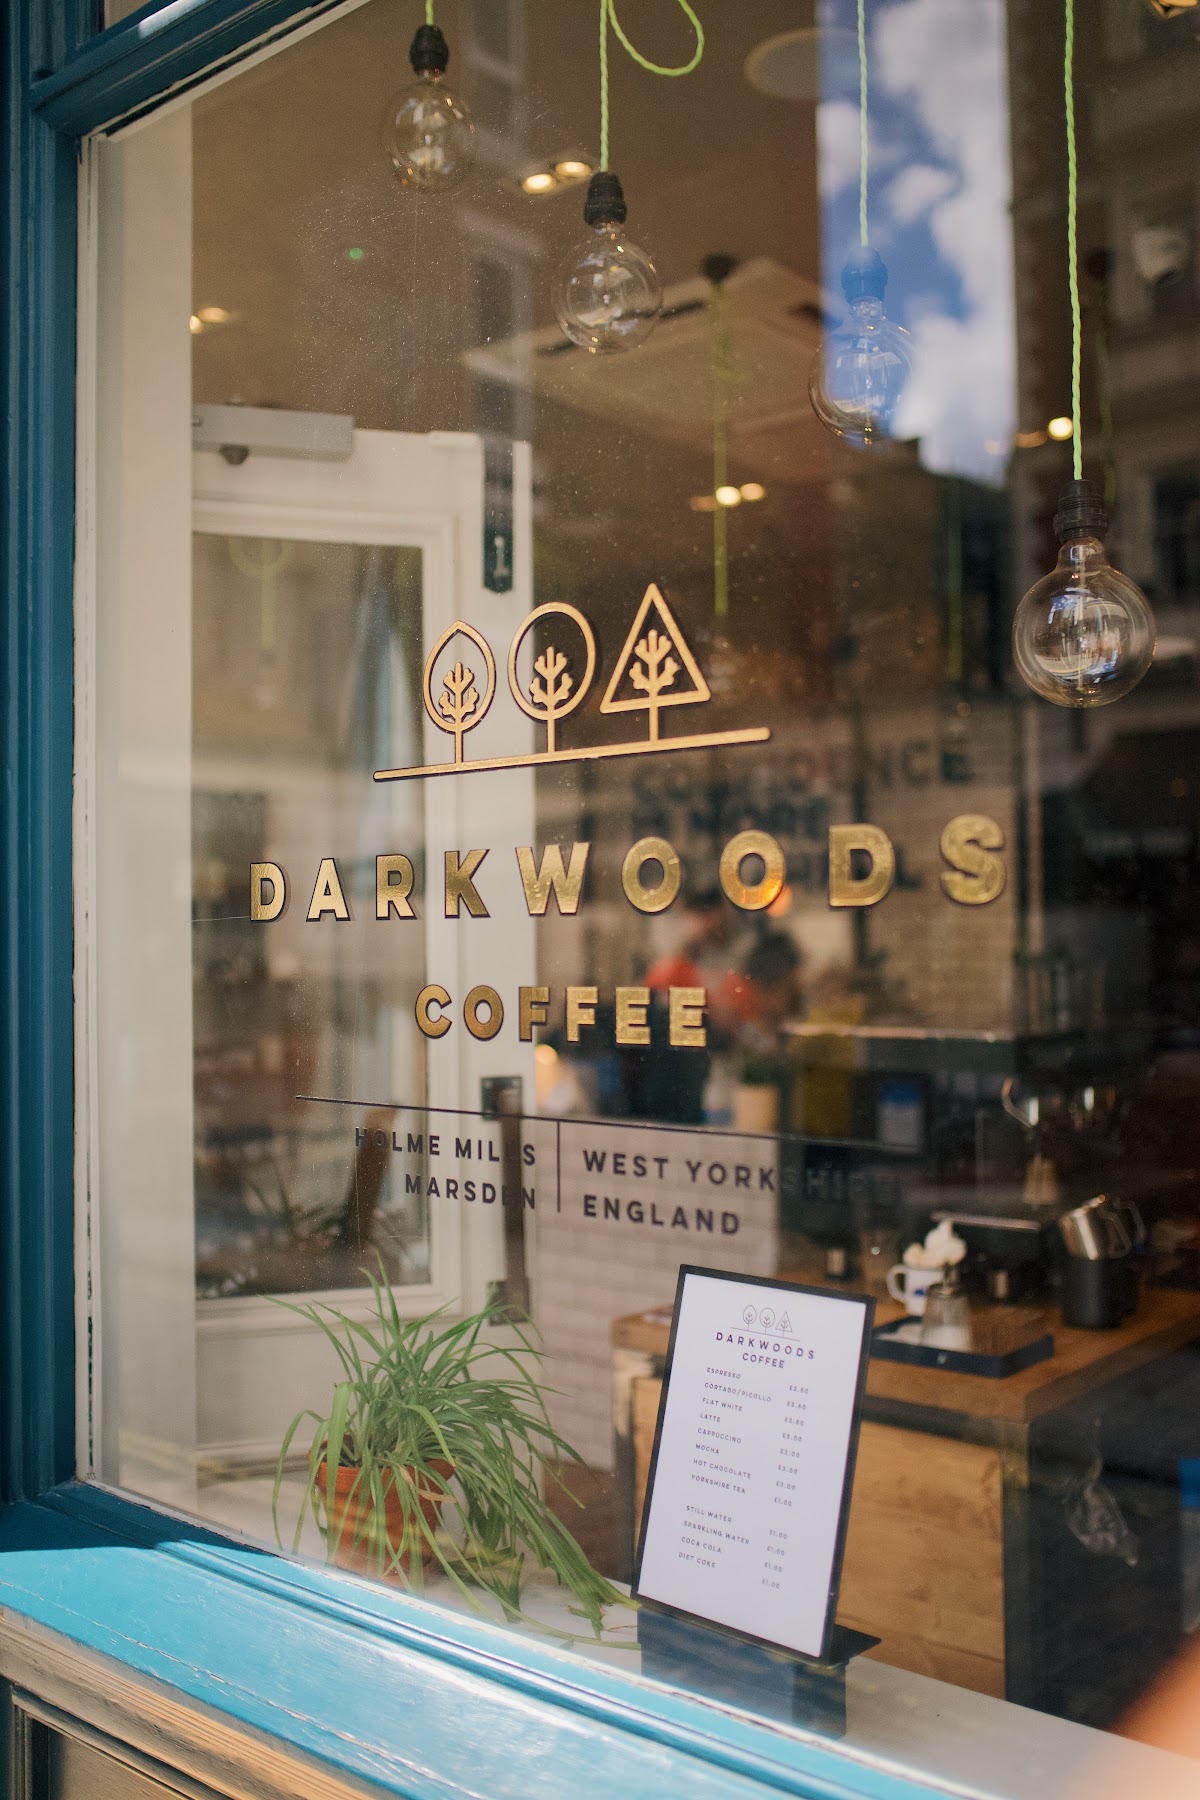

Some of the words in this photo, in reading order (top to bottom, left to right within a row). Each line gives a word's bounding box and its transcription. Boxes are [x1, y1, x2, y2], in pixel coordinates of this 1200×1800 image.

[250, 814, 1008, 923] DARKWOODS
[414, 984, 708, 1048] COFFEE
[355, 1127, 440, 1156] HOLME
[456, 1138, 536, 1166] MILS
[583, 1149, 669, 1180] WEST
[583, 1195, 740, 1236] ENGLAND
[715, 1331, 815, 1360] DARKWOODS
[742, 1352, 785, 1369] COFFEE
[706, 1367, 741, 1380] ESPRESSO
[704, 1382, 772, 1403] CORTADO/PICOLLO
[702, 1397, 719, 1407] FLAT
[721, 1402, 743, 1412] WHITE
[699, 1413, 721, 1423] LATTE
[697, 1428, 742, 1444] CAPPUCCINO
[695, 1443, 720, 1455] MOCHA
[693, 1458, 707, 1468] HOT
[709, 1462, 752, 1479] CHOCOLATE
[691, 1474, 730, 1490] YORKSHIRE
[733, 1485, 746, 1495] TEA
[686, 1505, 705, 1516] STILL
[707, 1511, 732, 1523] WATER
[683, 1520, 723, 1537] SPARKLING
[725, 1532, 750, 1545] WATER
[681, 1536, 700, 1547] COCA
[702, 1543, 722, 1554] COLA
[678, 1552, 694, 1561] DIET
[696, 1557, 716, 1569] COKE
